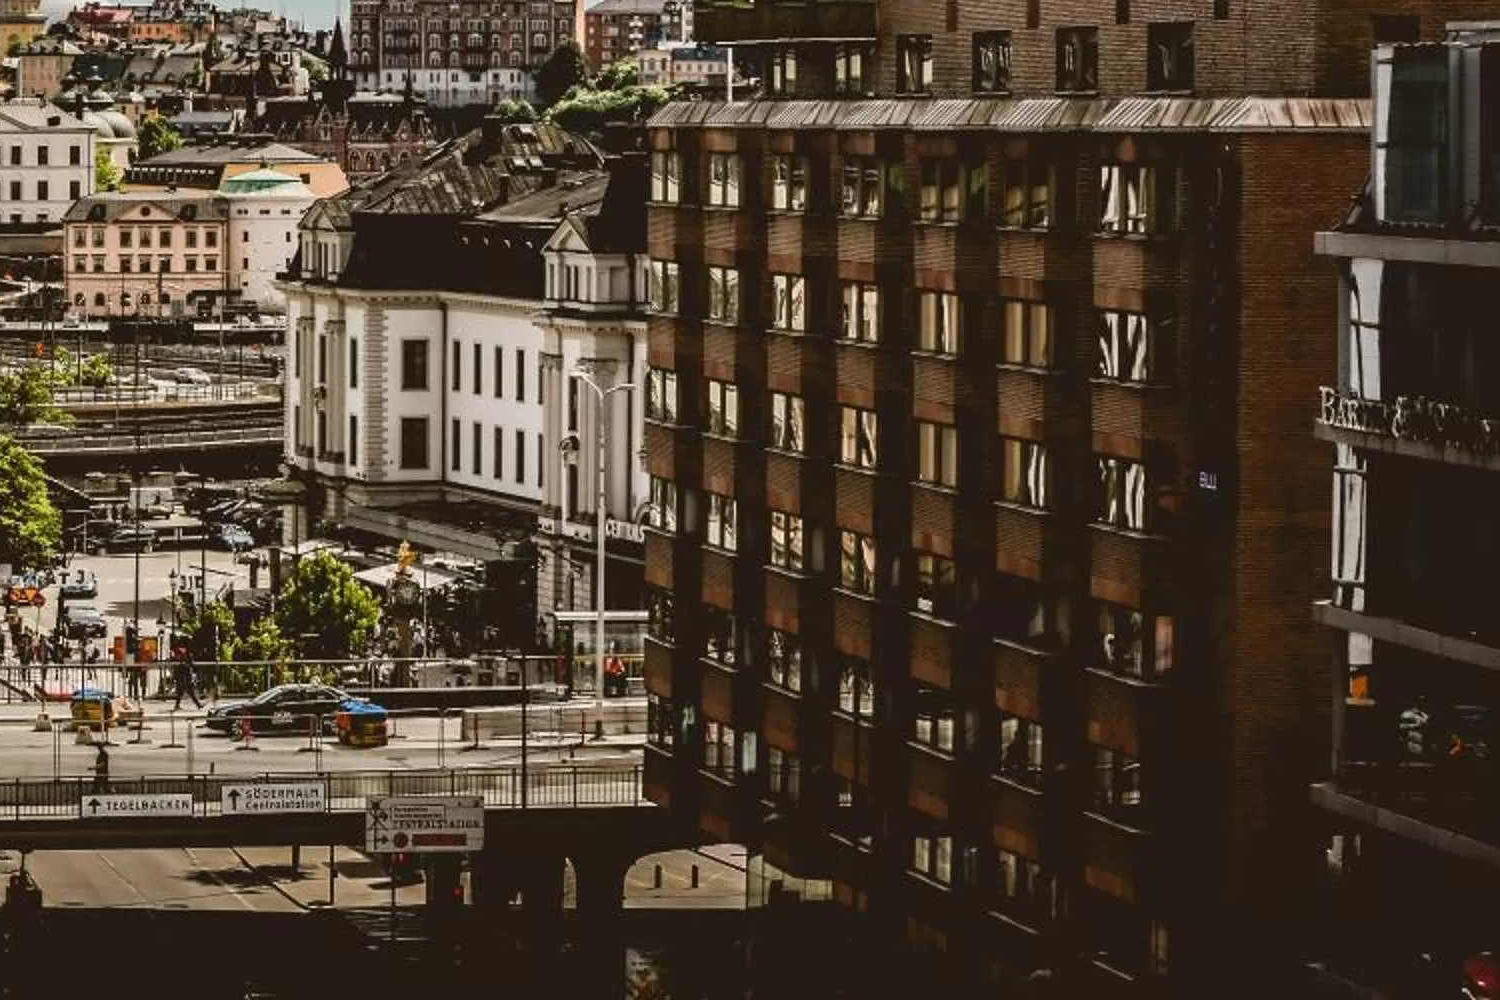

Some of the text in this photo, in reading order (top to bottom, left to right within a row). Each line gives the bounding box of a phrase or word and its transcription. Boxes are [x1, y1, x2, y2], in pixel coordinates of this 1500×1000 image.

[244, 787, 319, 799] SÖDERMALM
[106, 799, 190, 811] TEGELBACKEN
[244, 799, 322, 810] Centralstation
